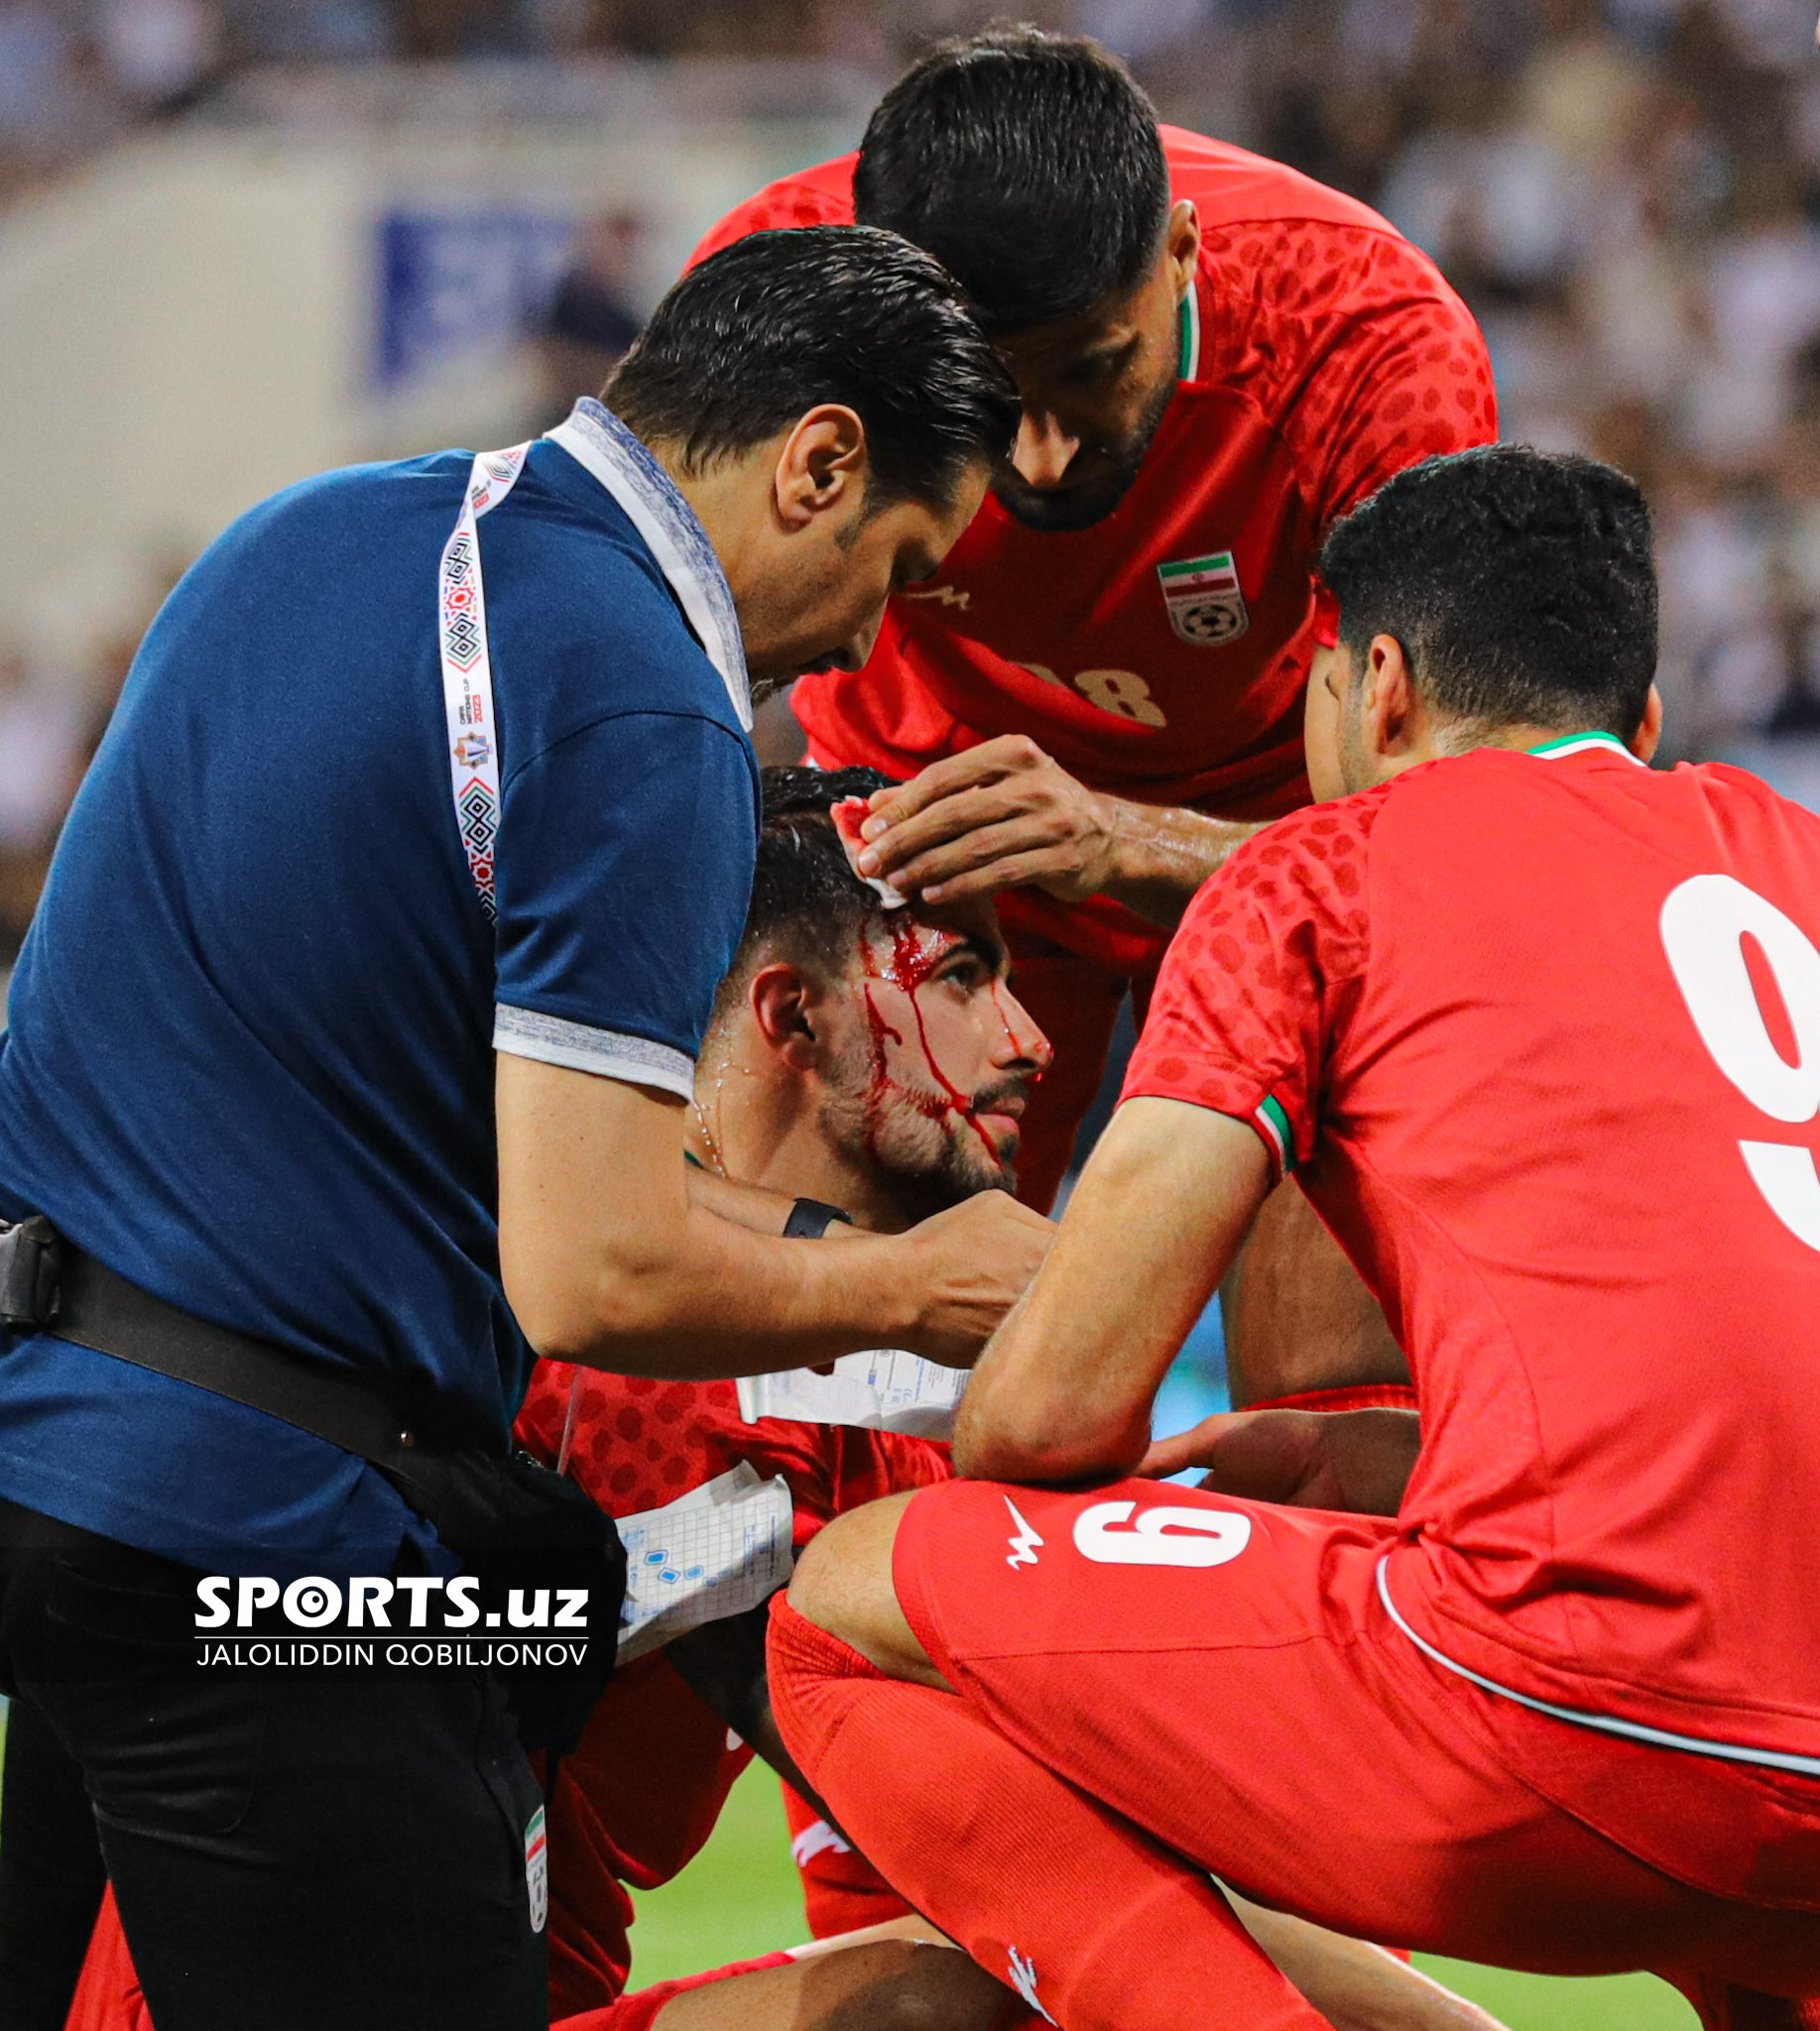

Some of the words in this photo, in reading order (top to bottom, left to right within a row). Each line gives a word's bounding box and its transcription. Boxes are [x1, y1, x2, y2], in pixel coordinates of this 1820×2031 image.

[472, 694, 483, 723] 2023
[1008, 662, 1167, 728] 8
[1658, 873, 1820, 1253] 9
